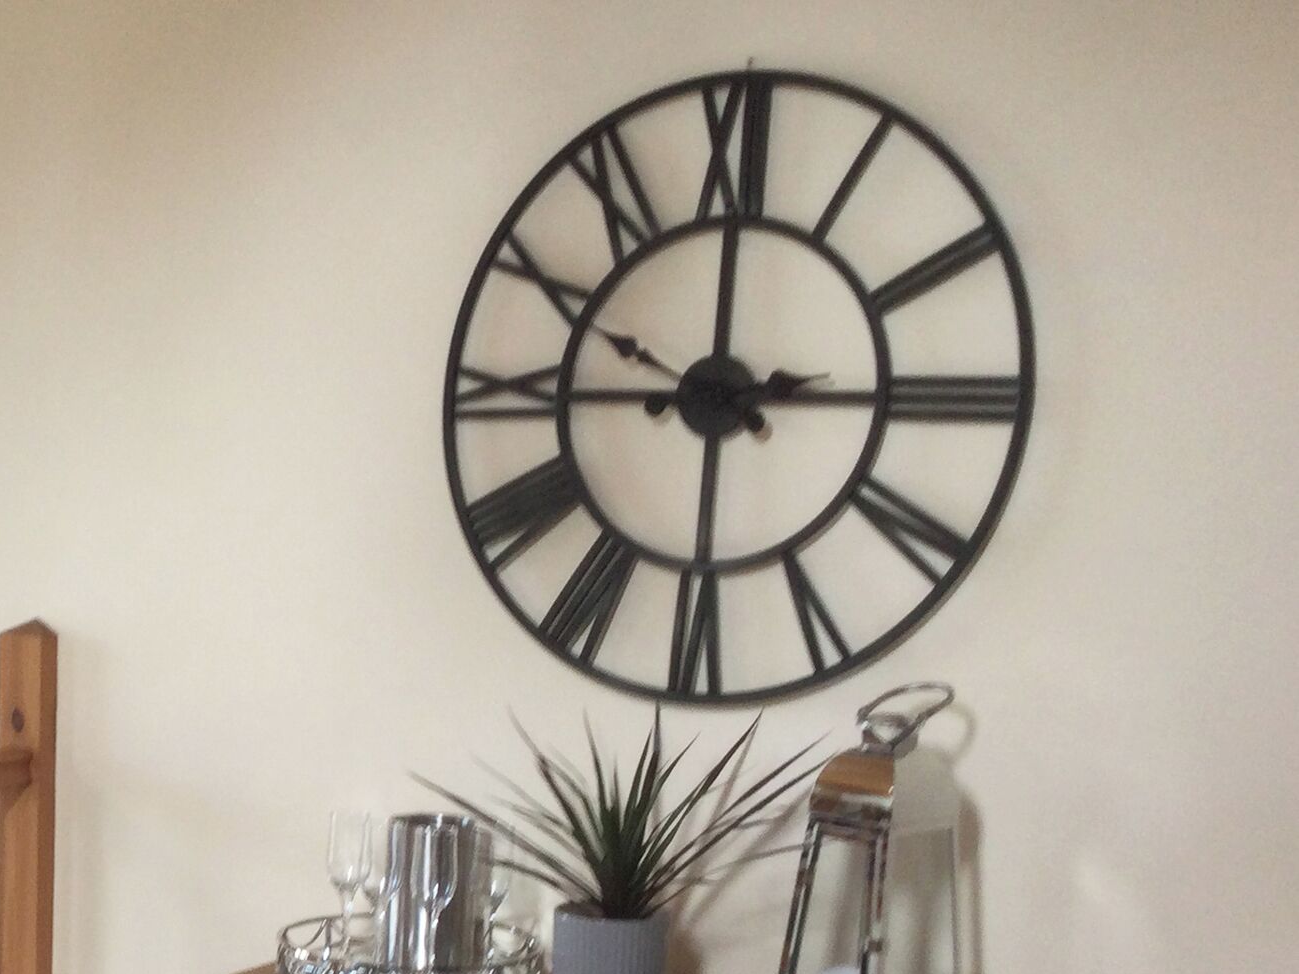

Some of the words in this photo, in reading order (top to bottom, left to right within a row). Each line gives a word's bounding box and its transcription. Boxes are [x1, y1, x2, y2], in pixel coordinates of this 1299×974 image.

[561, 120, 663, 268] XI
[694, 73, 775, 222] XII
[489, 228, 594, 330] X
[781, 545, 853, 678] V
